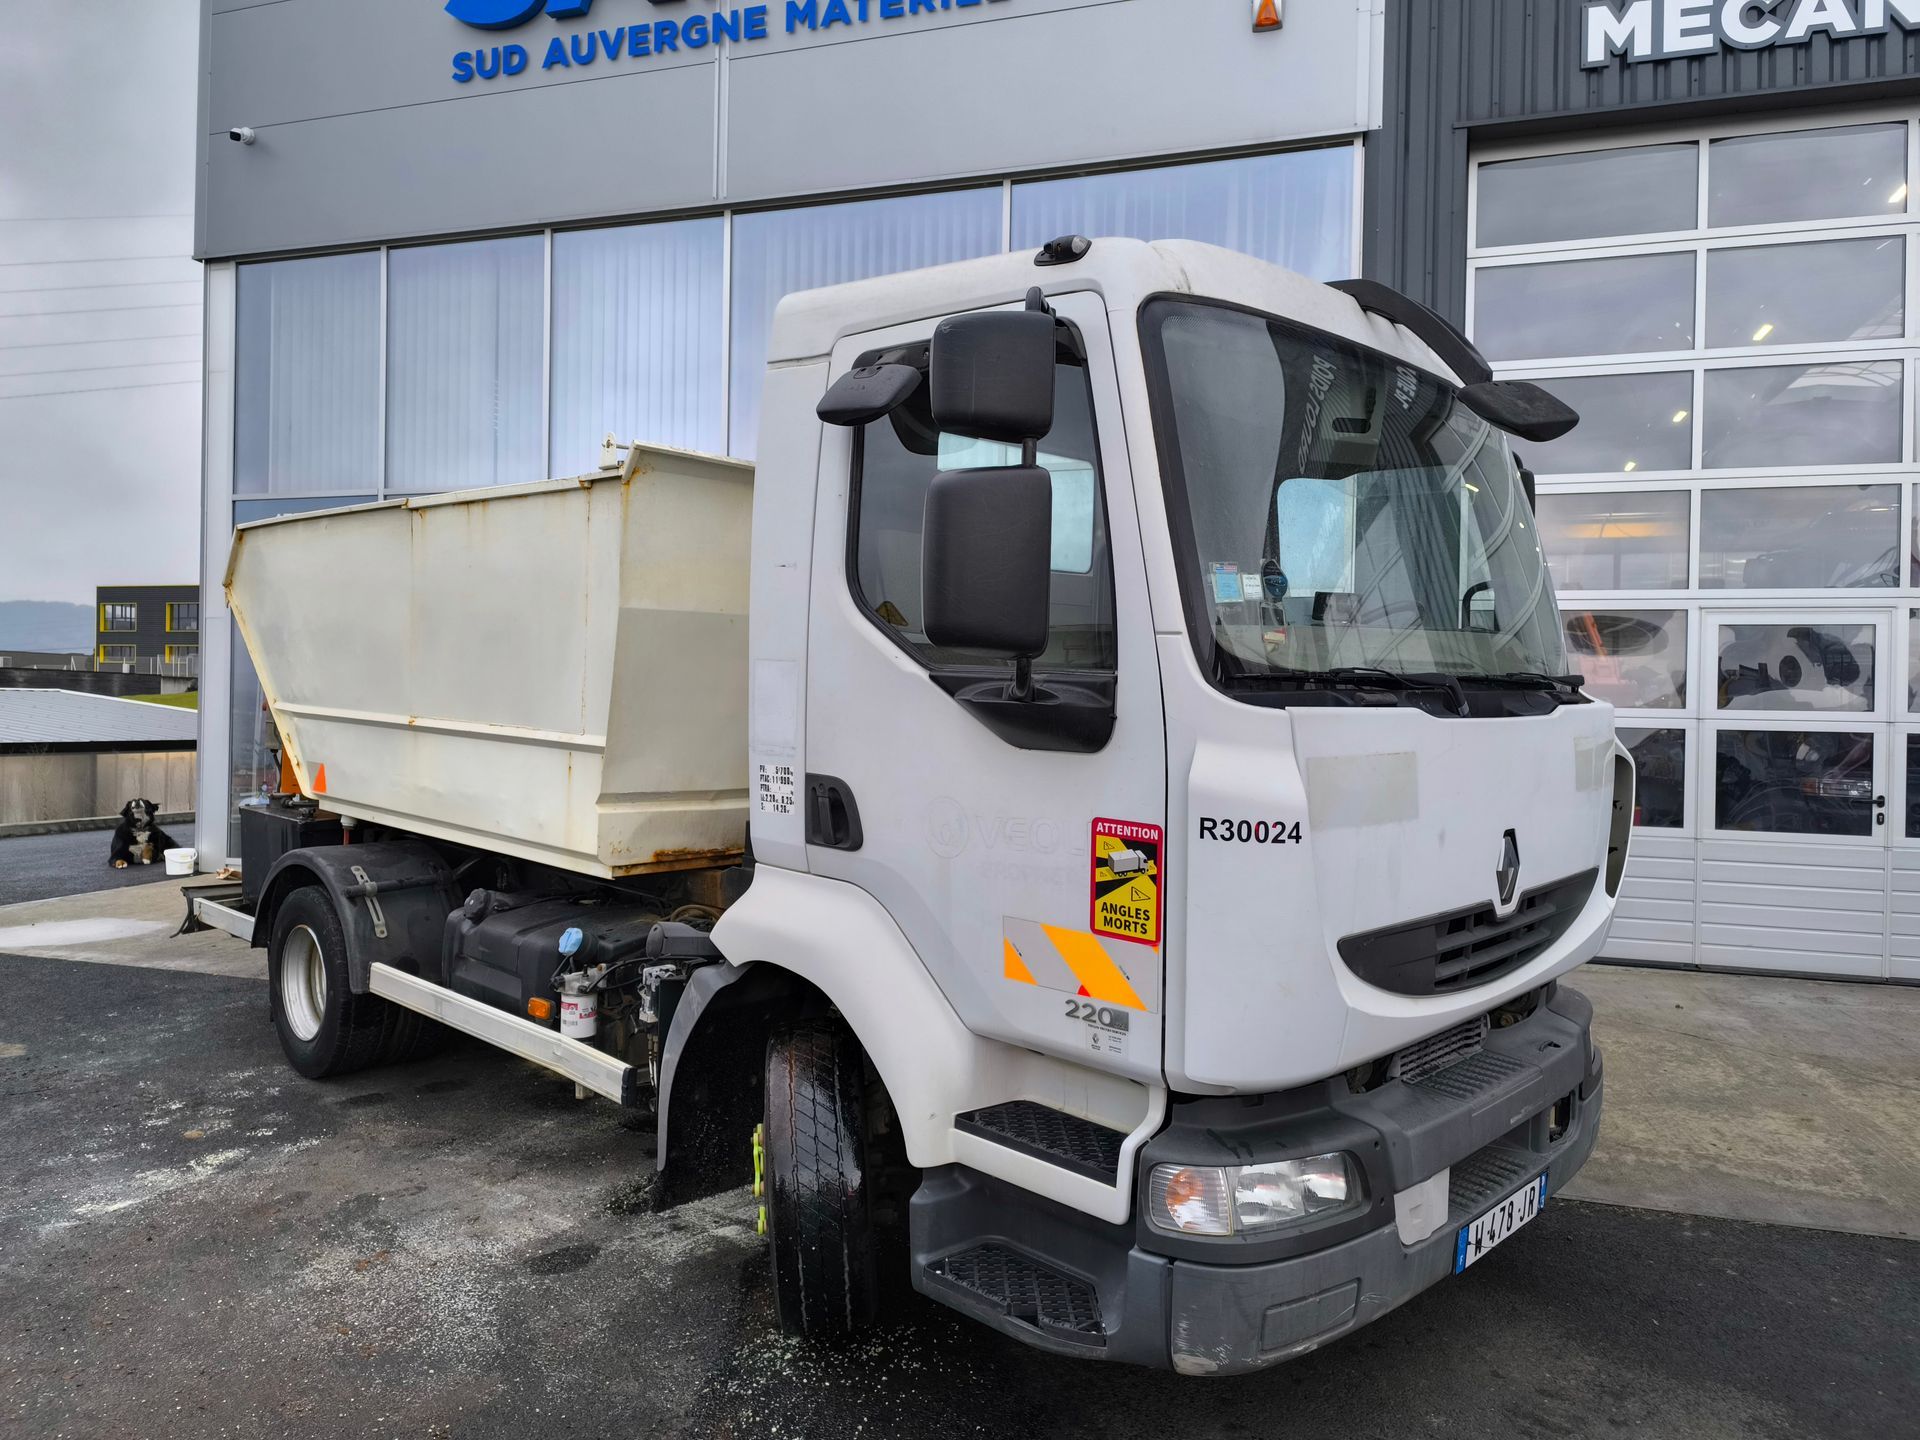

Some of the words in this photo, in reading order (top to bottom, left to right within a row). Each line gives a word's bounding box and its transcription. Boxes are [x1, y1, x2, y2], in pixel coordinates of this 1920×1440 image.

[451, 44, 529, 84] SUD
[542, 4, 768, 69] AUVERGNE
[1096, 822, 1159, 841] ATTENTION
[1200, 816, 1302, 845] R30024
[1100, 902, 1150, 921] ANGLES
[1103, 915, 1148, 935] MORTS
[1065, 999, 1113, 1028] 220
